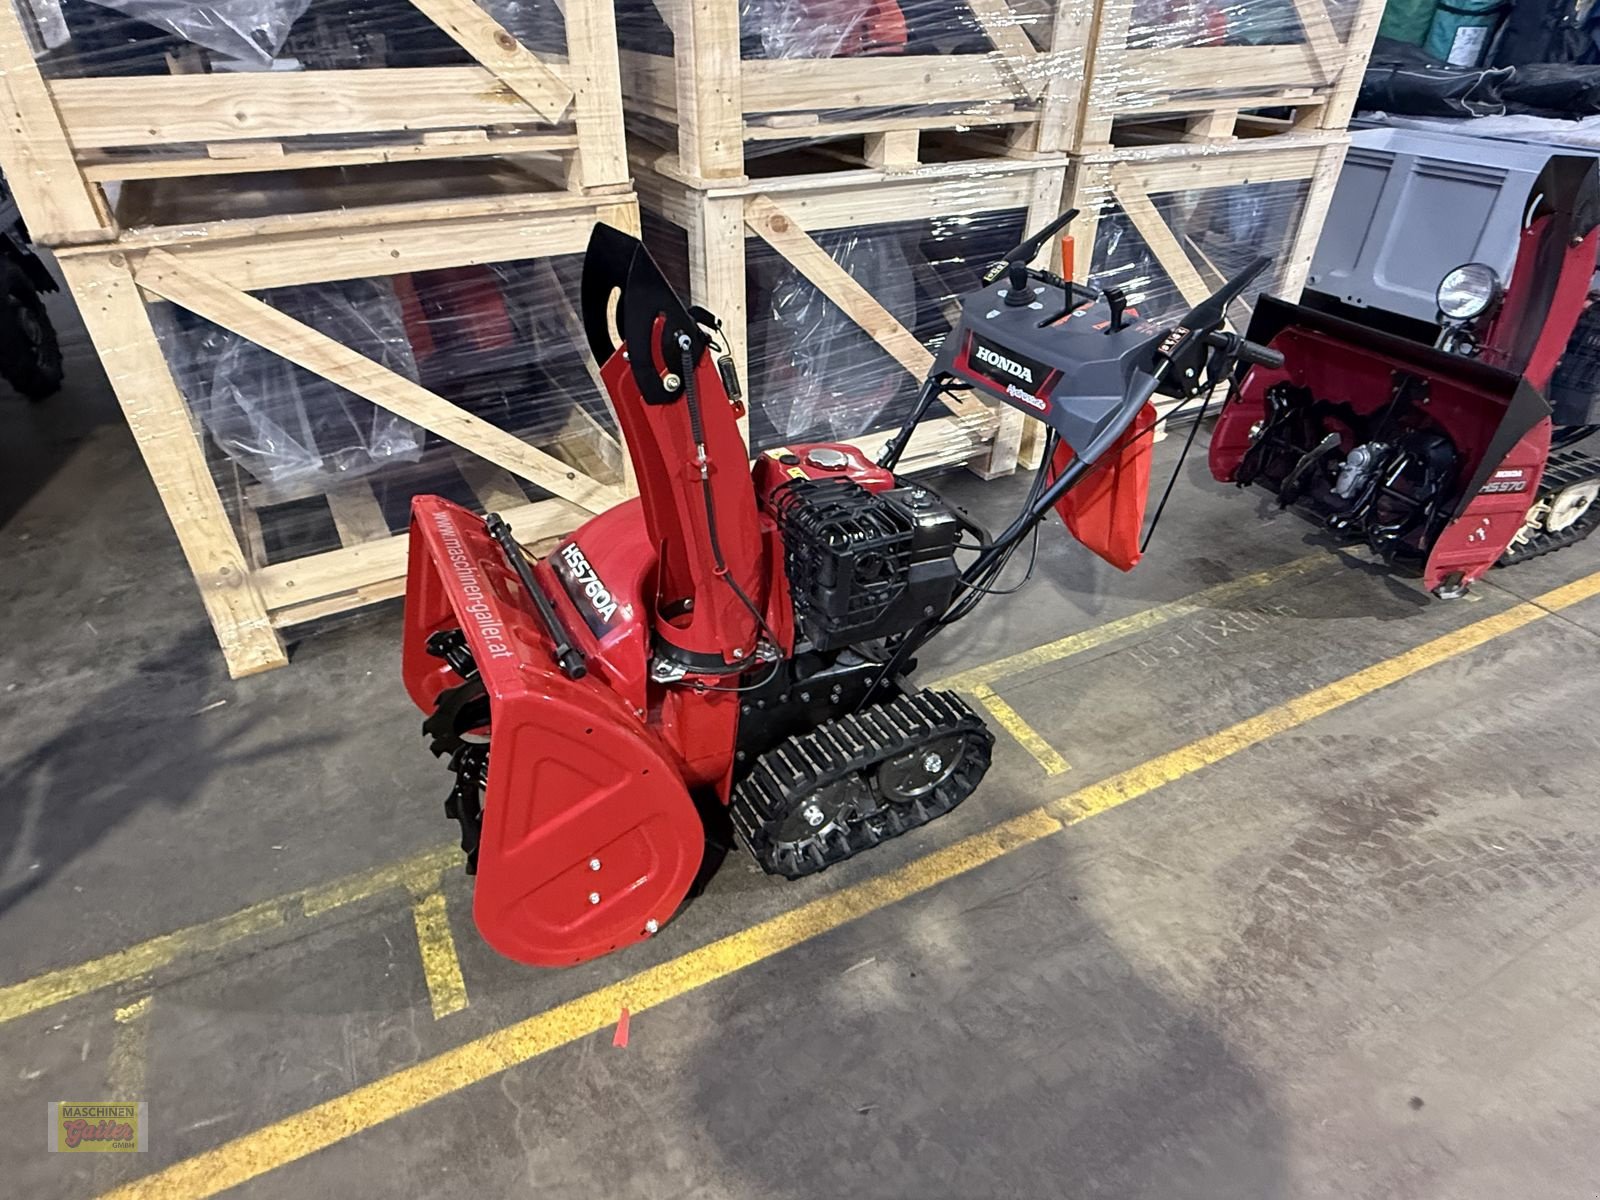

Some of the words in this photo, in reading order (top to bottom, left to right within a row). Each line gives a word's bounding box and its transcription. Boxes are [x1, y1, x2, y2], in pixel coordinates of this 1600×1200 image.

[976, 346, 1033, 384] HONDA
[432, 511, 515, 659] www.maschinen-gailer.at
[562, 543, 618, 623] HSS760A
